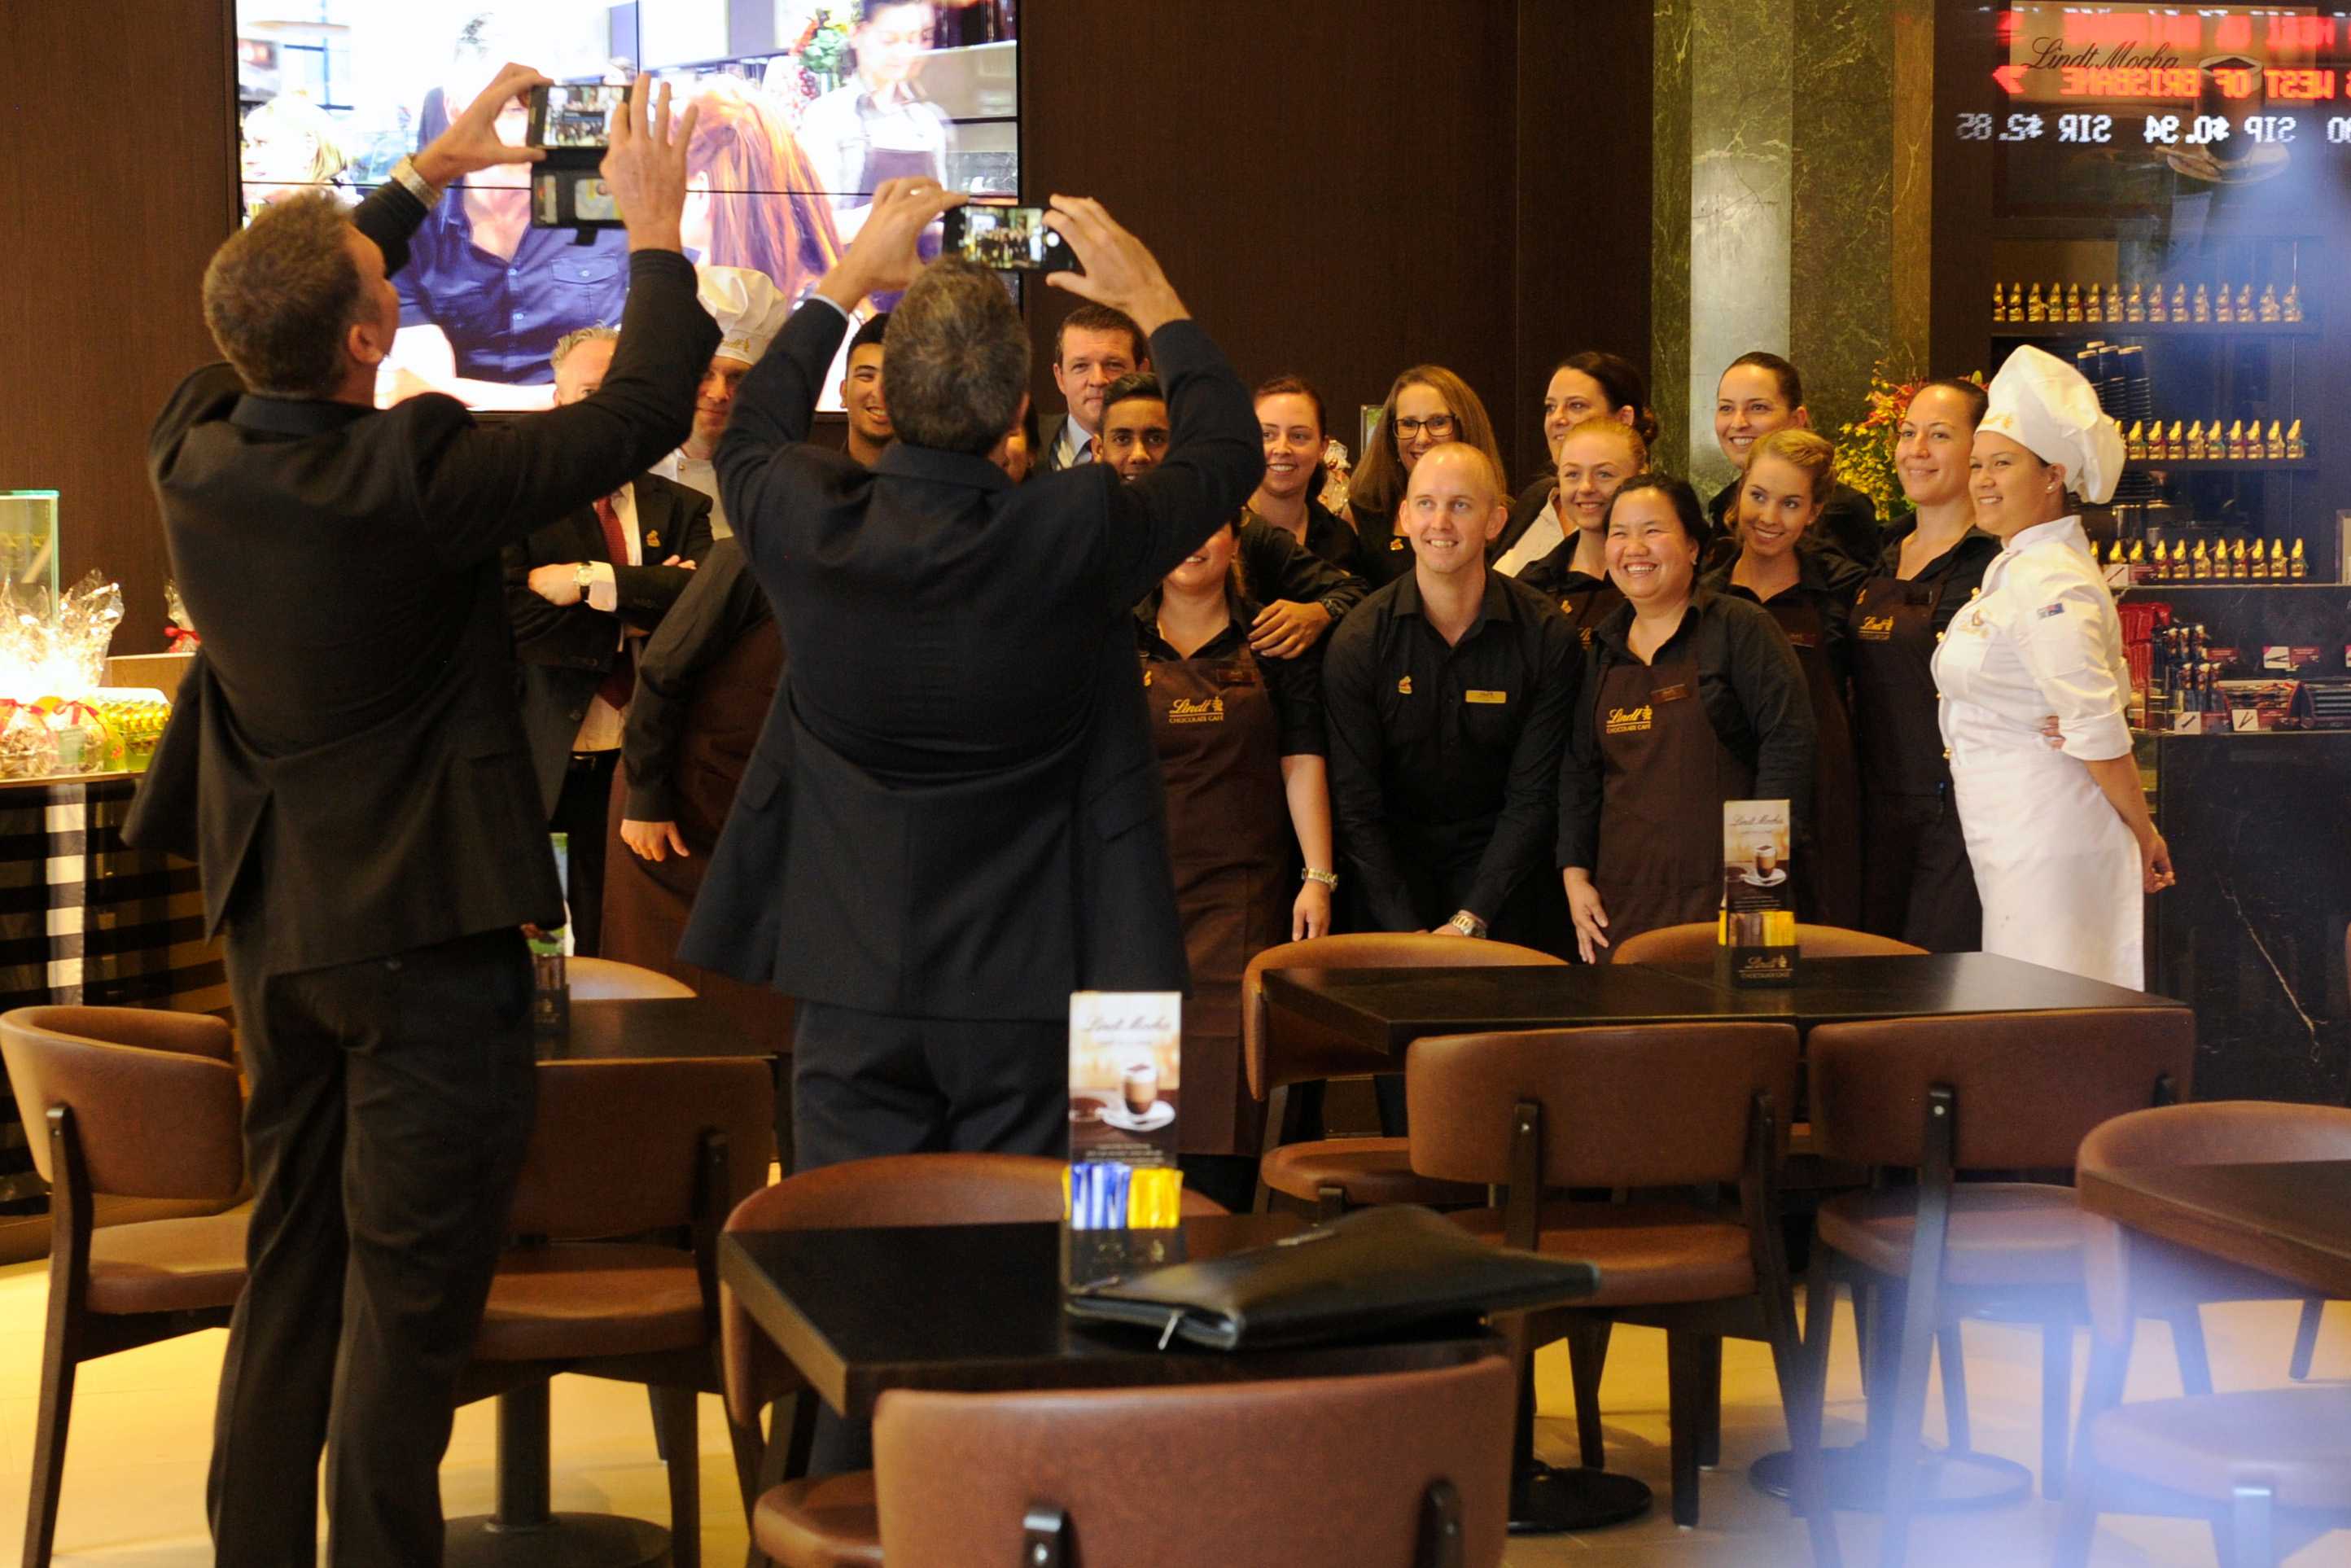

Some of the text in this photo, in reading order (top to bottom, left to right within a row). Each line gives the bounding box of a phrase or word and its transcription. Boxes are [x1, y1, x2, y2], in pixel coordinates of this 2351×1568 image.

[2020, 37, 2179, 70] Lindt Mocha
[1169, 699, 1212, 714] Lindt
[1606, 707, 1643, 725] Lindt
